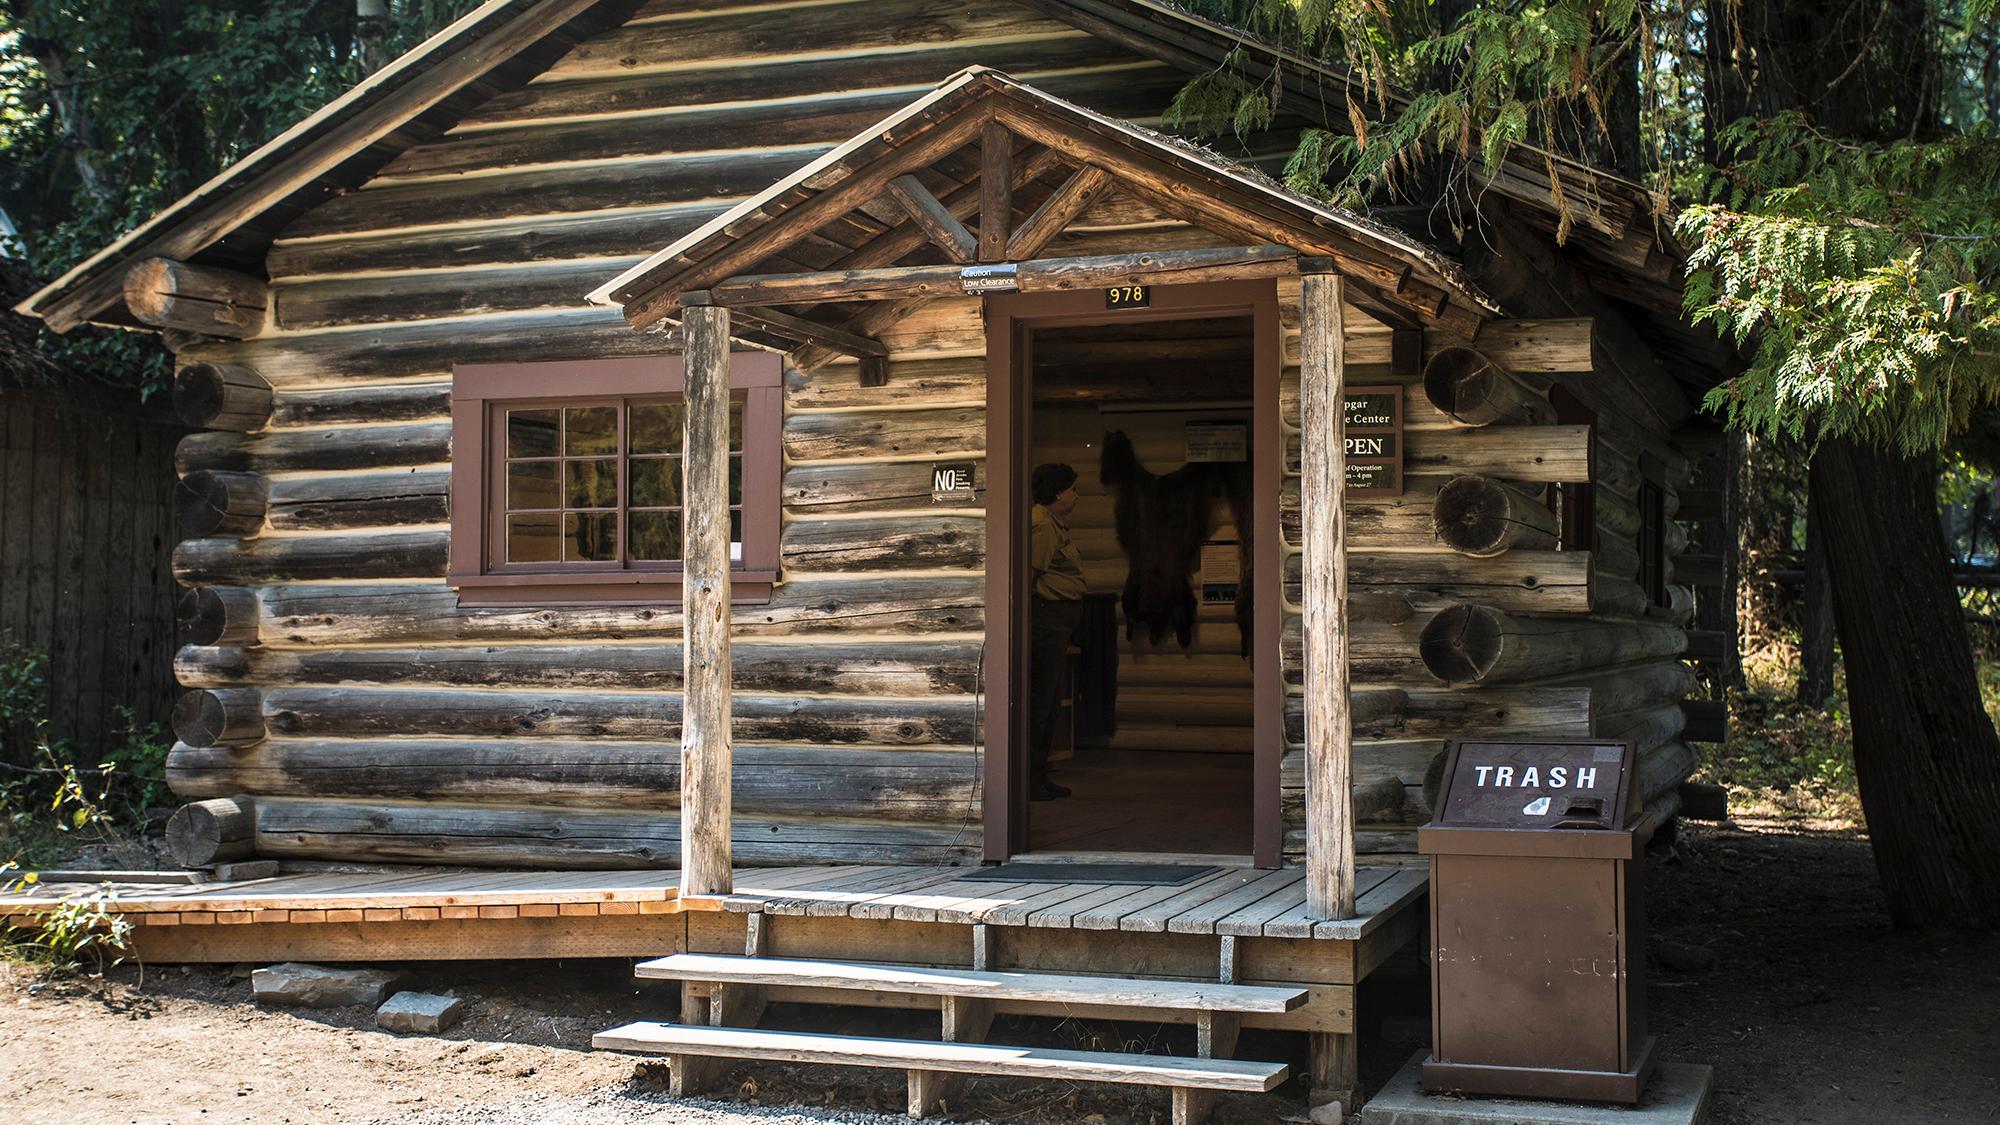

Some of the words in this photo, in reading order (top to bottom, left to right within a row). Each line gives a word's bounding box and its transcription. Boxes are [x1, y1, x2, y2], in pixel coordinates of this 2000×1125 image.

[963, 279, 979, 288] Low
[980, 277, 1015, 287] Clearance
[1110, 286, 1142, 303] 978
[1344, 401, 1368, 411] pgar
[1353, 414, 1390, 424] Center
[1344, 438, 1383, 455] PEN
[1350, 464, 1383, 473] Operation
[935, 469, 956, 491] NO
[1475, 766, 1597, 789] TRASH
